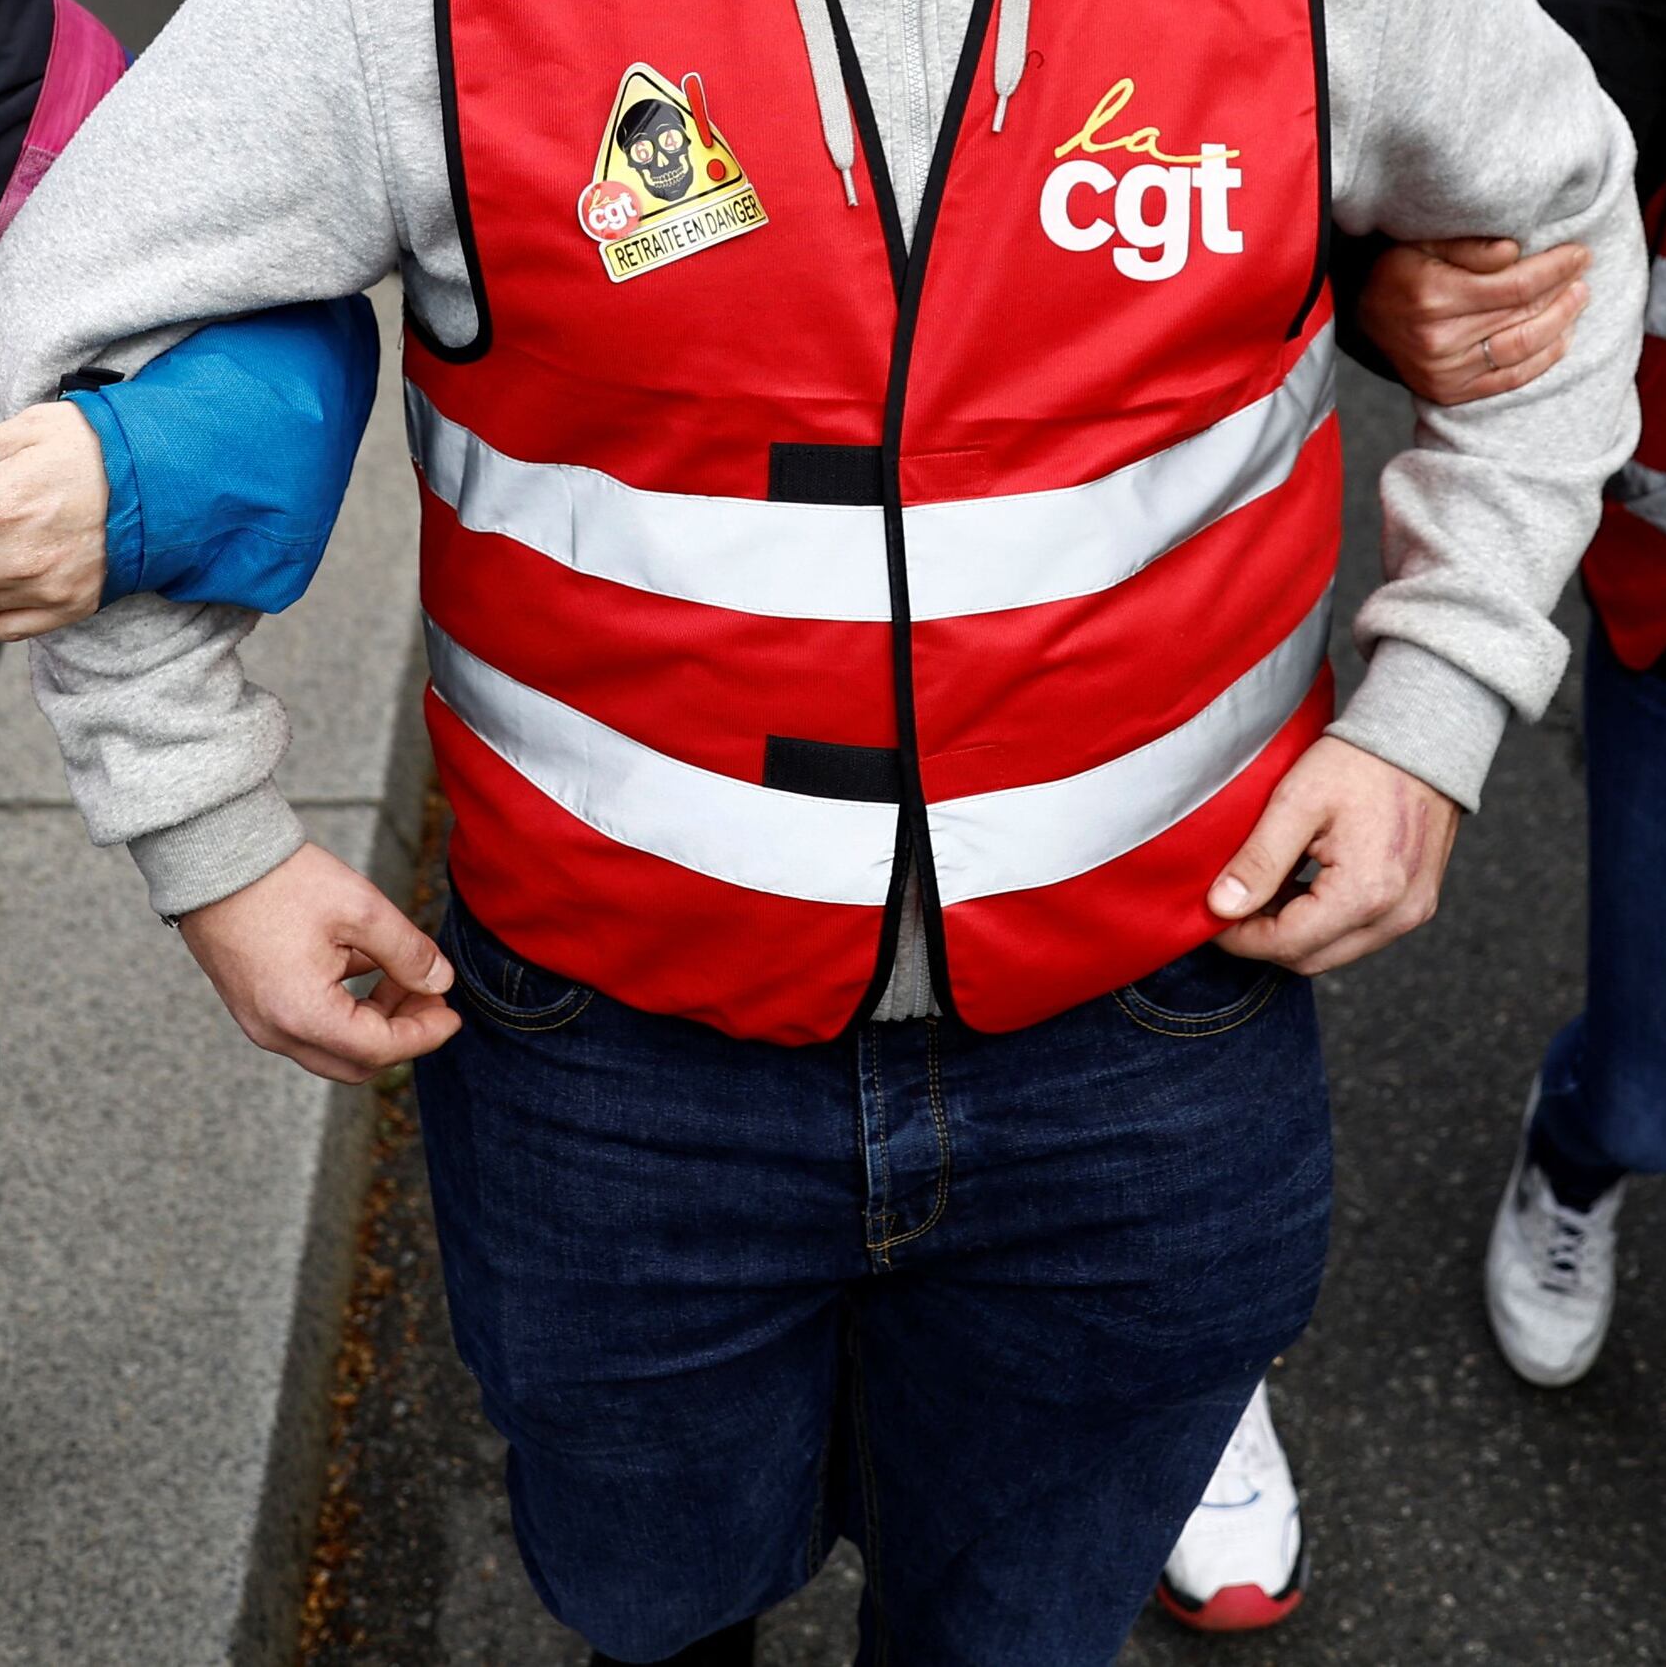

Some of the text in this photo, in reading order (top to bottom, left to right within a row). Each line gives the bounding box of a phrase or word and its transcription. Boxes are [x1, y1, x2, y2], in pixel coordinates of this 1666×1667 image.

[588, 192, 637, 230] cgt
[589, 189, 614, 210] la
[1039, 143, 1244, 282] cgt
[614, 194, 762, 271] RETRAITE EN DANGER
